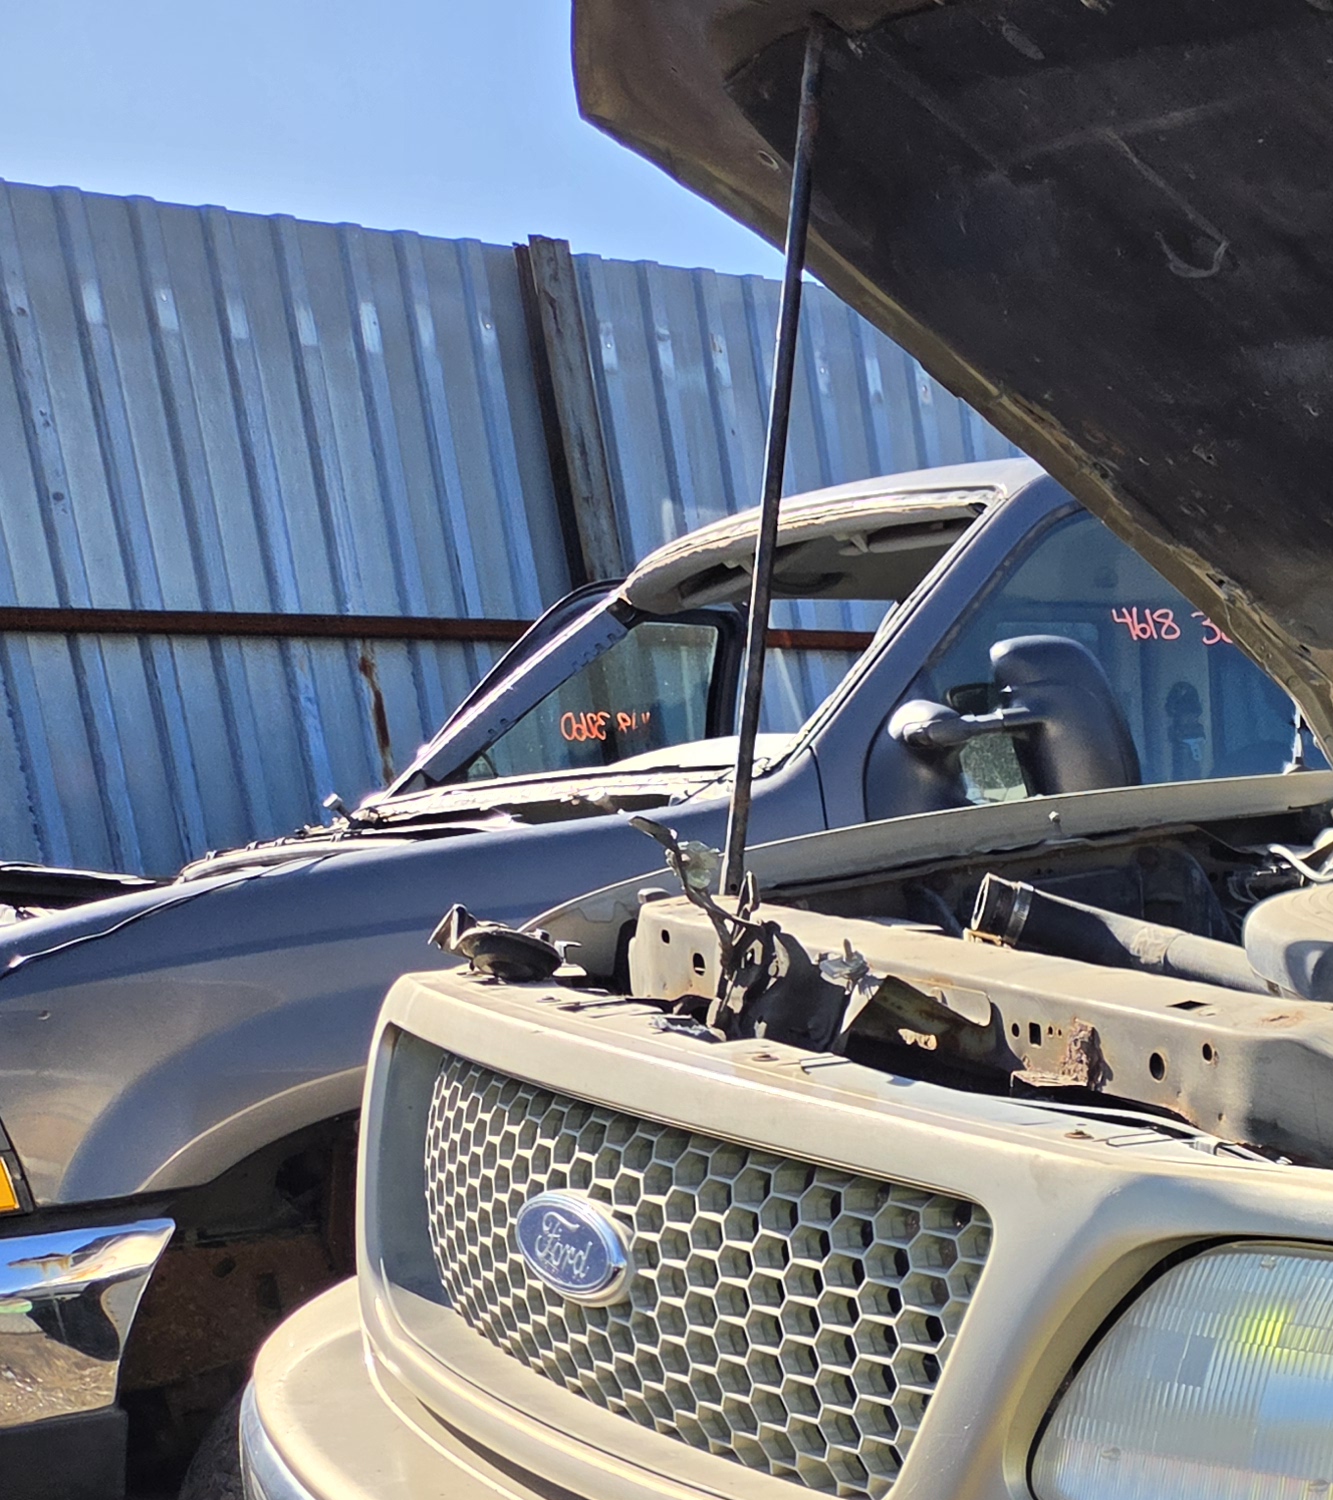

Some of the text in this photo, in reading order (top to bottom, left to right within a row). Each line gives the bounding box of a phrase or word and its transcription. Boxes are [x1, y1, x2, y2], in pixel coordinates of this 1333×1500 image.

[1111, 606, 1234, 645] 4618 3
[534, 1211, 593, 1280] Ford
